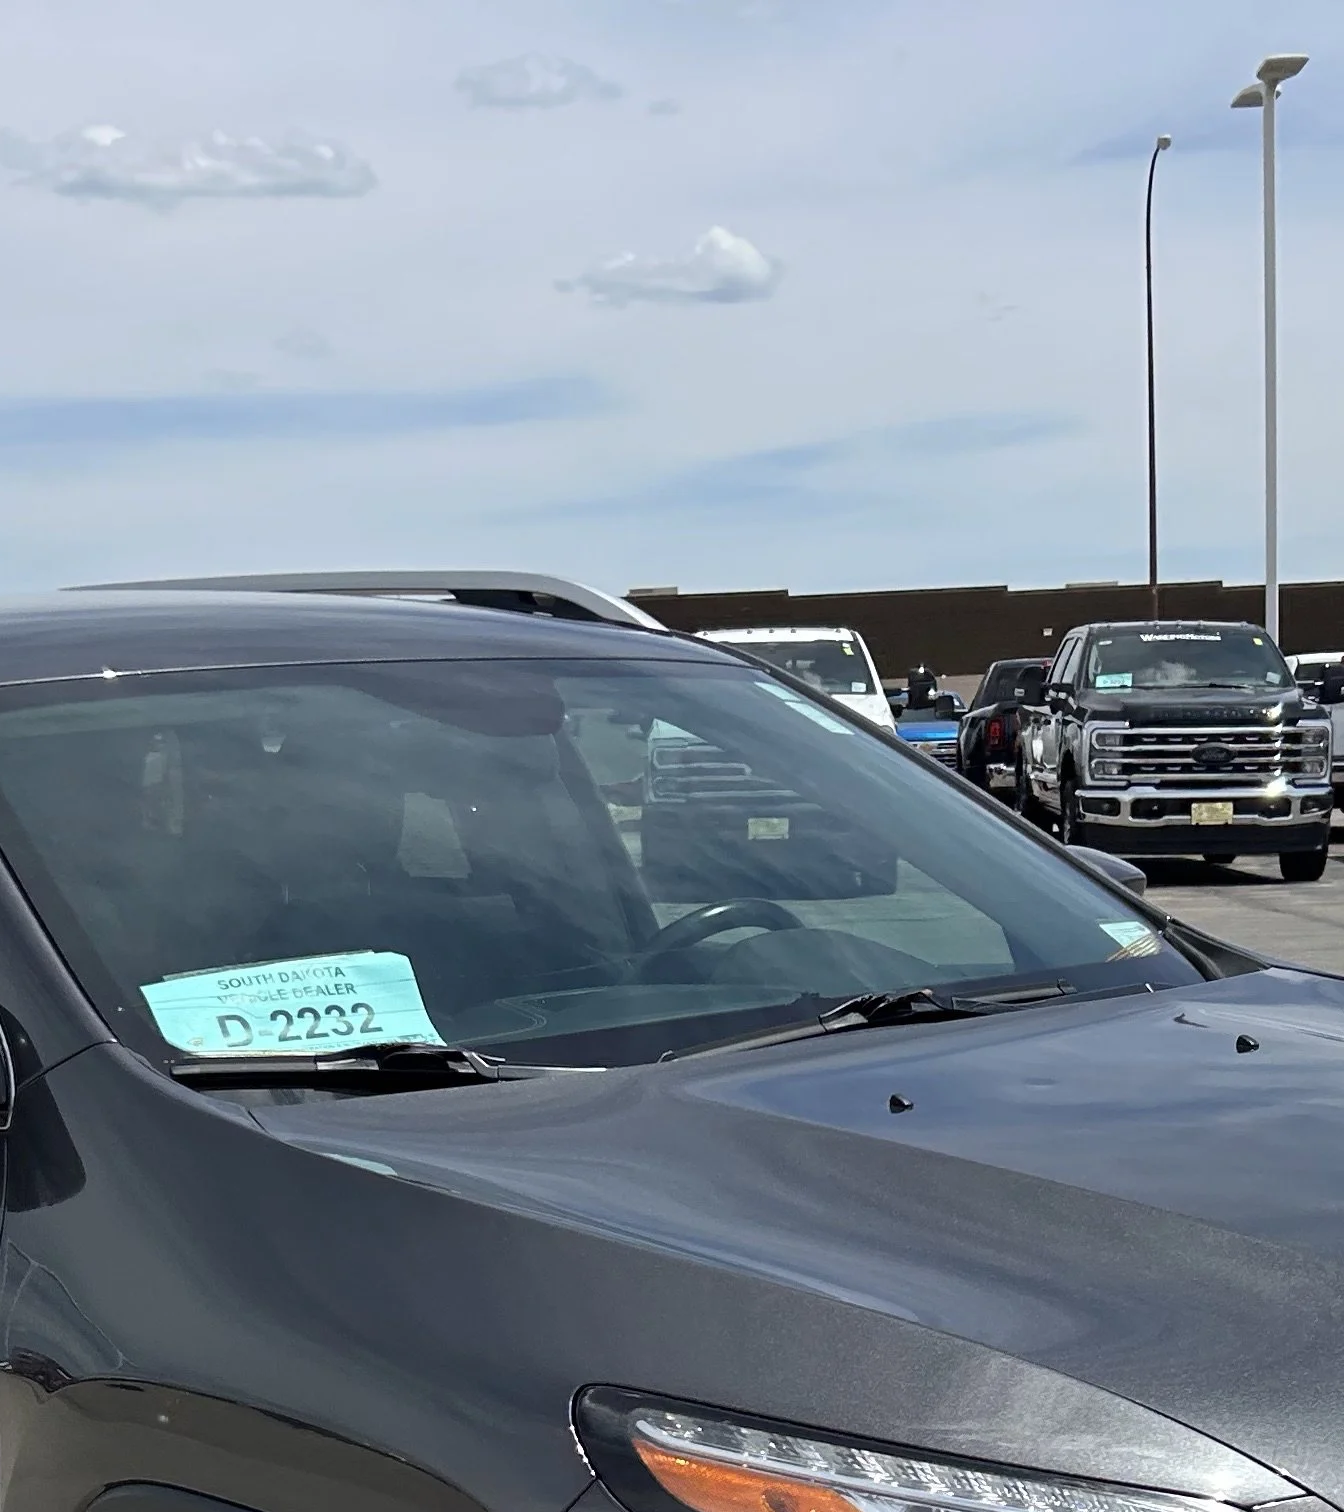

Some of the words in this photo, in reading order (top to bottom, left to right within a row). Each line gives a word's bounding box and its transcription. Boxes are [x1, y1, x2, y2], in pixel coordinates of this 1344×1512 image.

[217, 973, 275, 990] SOUTH
[292, 983, 357, 999] DEALER
[216, 1003, 383, 1047] D-2232
